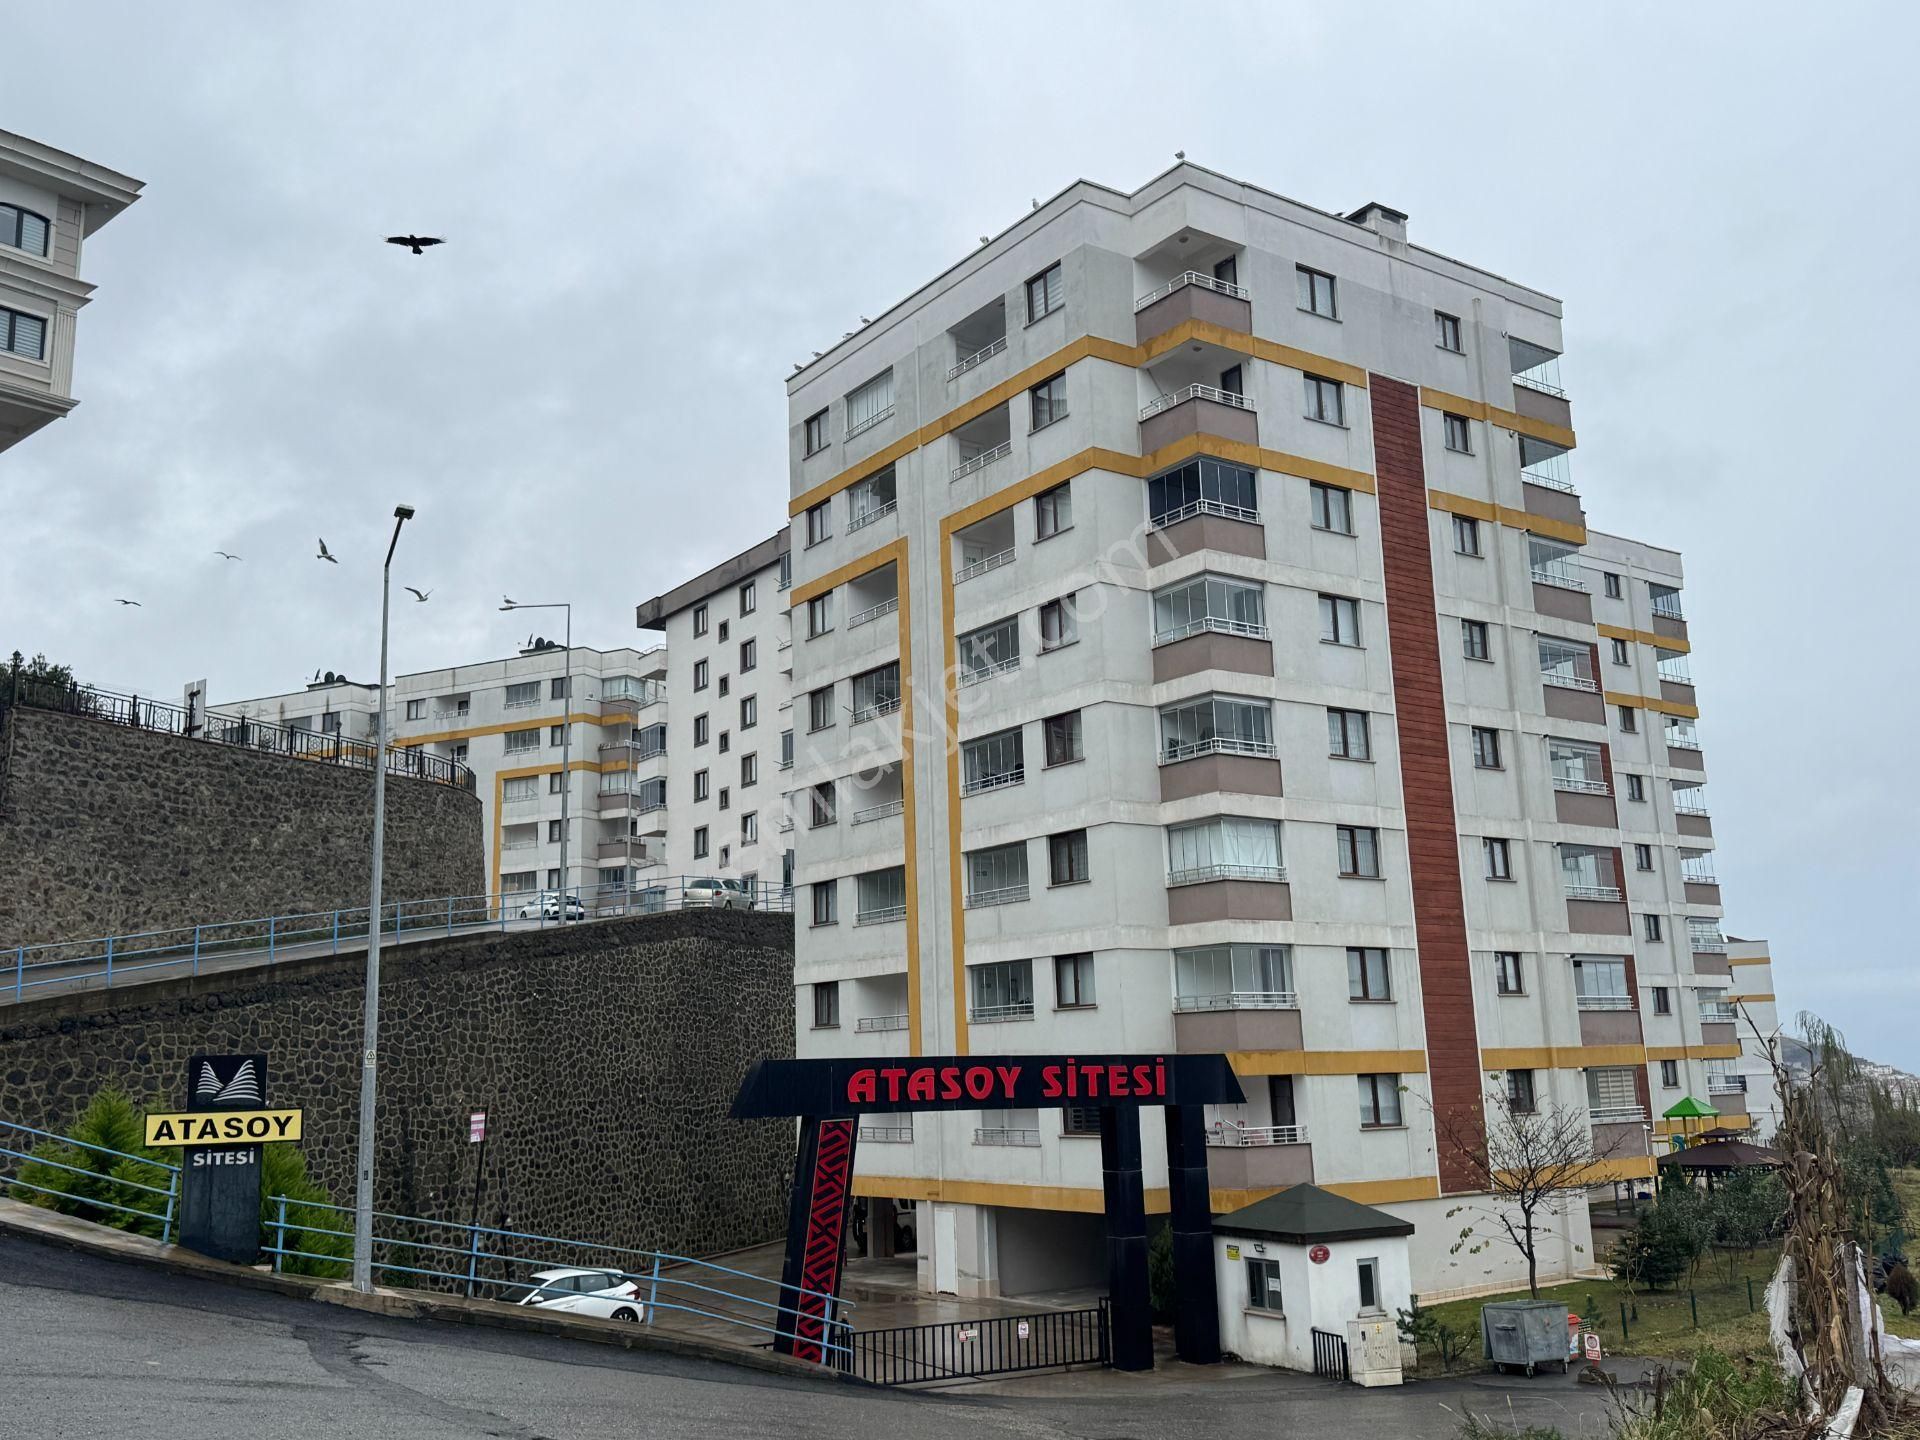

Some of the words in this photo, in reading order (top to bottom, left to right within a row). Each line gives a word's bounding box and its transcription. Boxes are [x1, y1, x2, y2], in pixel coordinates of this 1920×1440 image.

[847, 1066, 1022, 1102] ATASOY
[1042, 1057, 1166, 1097] SİTESİ
[152, 1115, 294, 1141] ATASOY
[193, 1147, 255, 1167] SİTESİ
